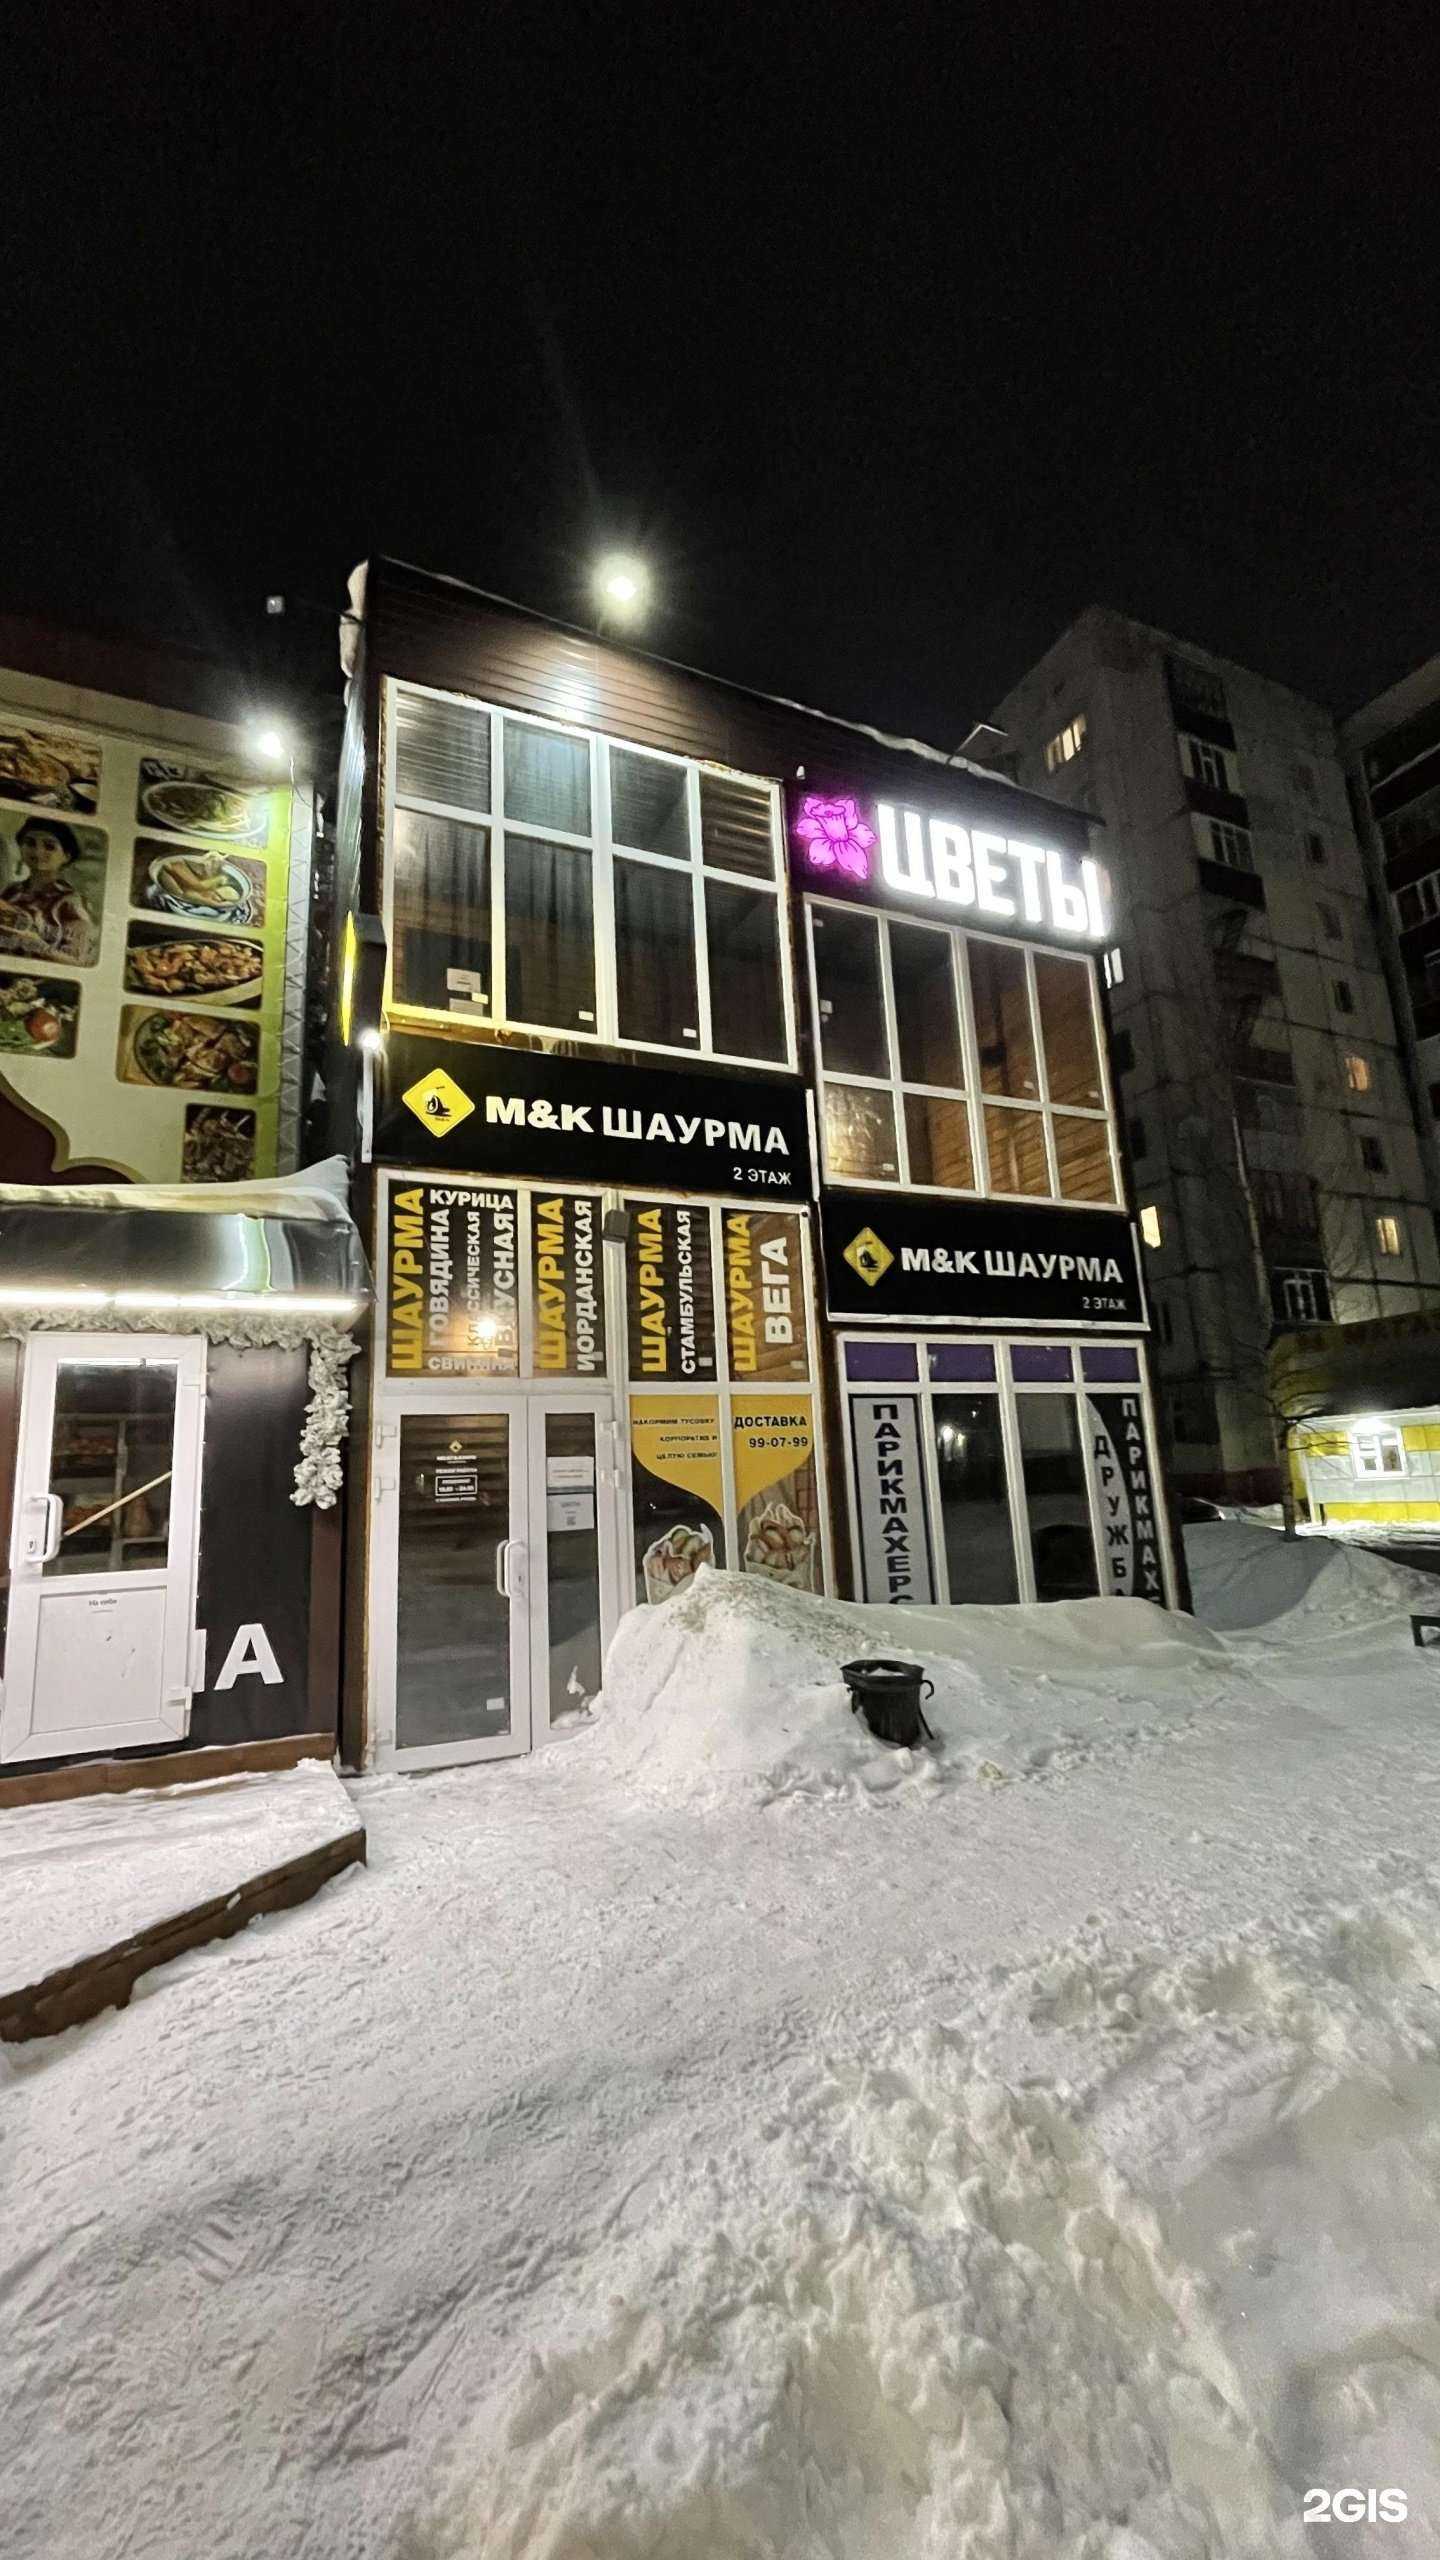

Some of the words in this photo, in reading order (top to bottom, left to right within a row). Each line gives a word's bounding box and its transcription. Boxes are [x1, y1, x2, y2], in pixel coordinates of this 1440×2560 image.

[877, 803, 1105, 937] ЦВЕТЫ
[486, 1095, 594, 1133] М&К
[602, 1105, 790, 1155] ШАУРМА
[733, 1166, 742, 1180] 2
[747, 1168, 791, 1186] ЭТАЖ
[430, 1189, 514, 1211] КУРИЦА
[901, 1247, 980, 1274] М&К
[984, 1251, 1123, 1283] ШАУРМА
[392, 1188, 424, 1369] ШАУРМА
[430, 1209, 453, 1346] ГОВЯДИНА
[467, 1211, 481, 1347] КЛССИЧЕСКАЯ
[493, 1211, 515, 1347] ВУСНАЯ
[537, 1198, 567, 1369] ШАУРМА
[575, 1200, 597, 1371] ИОРДАНСКАЯ
[638, 1209, 667, 1372] ШАУРМА
[677, 1210, 696, 1374] СТАМБУЛЬСКАЯ
[727, 1213, 757, 1371] ШАУРМА
[760, 1237, 793, 1344] ВЕГА
[1083, 1297, 1090, 1309] 2
[1094, 1297, 1127, 1310] ЭТАЖ
[734, 1415, 807, 1429] ДОСТАВКА
[749, 1436, 808, 1449] 99-07-99
[1121, 1398, 1161, 1601] ПАРИКМАХ
